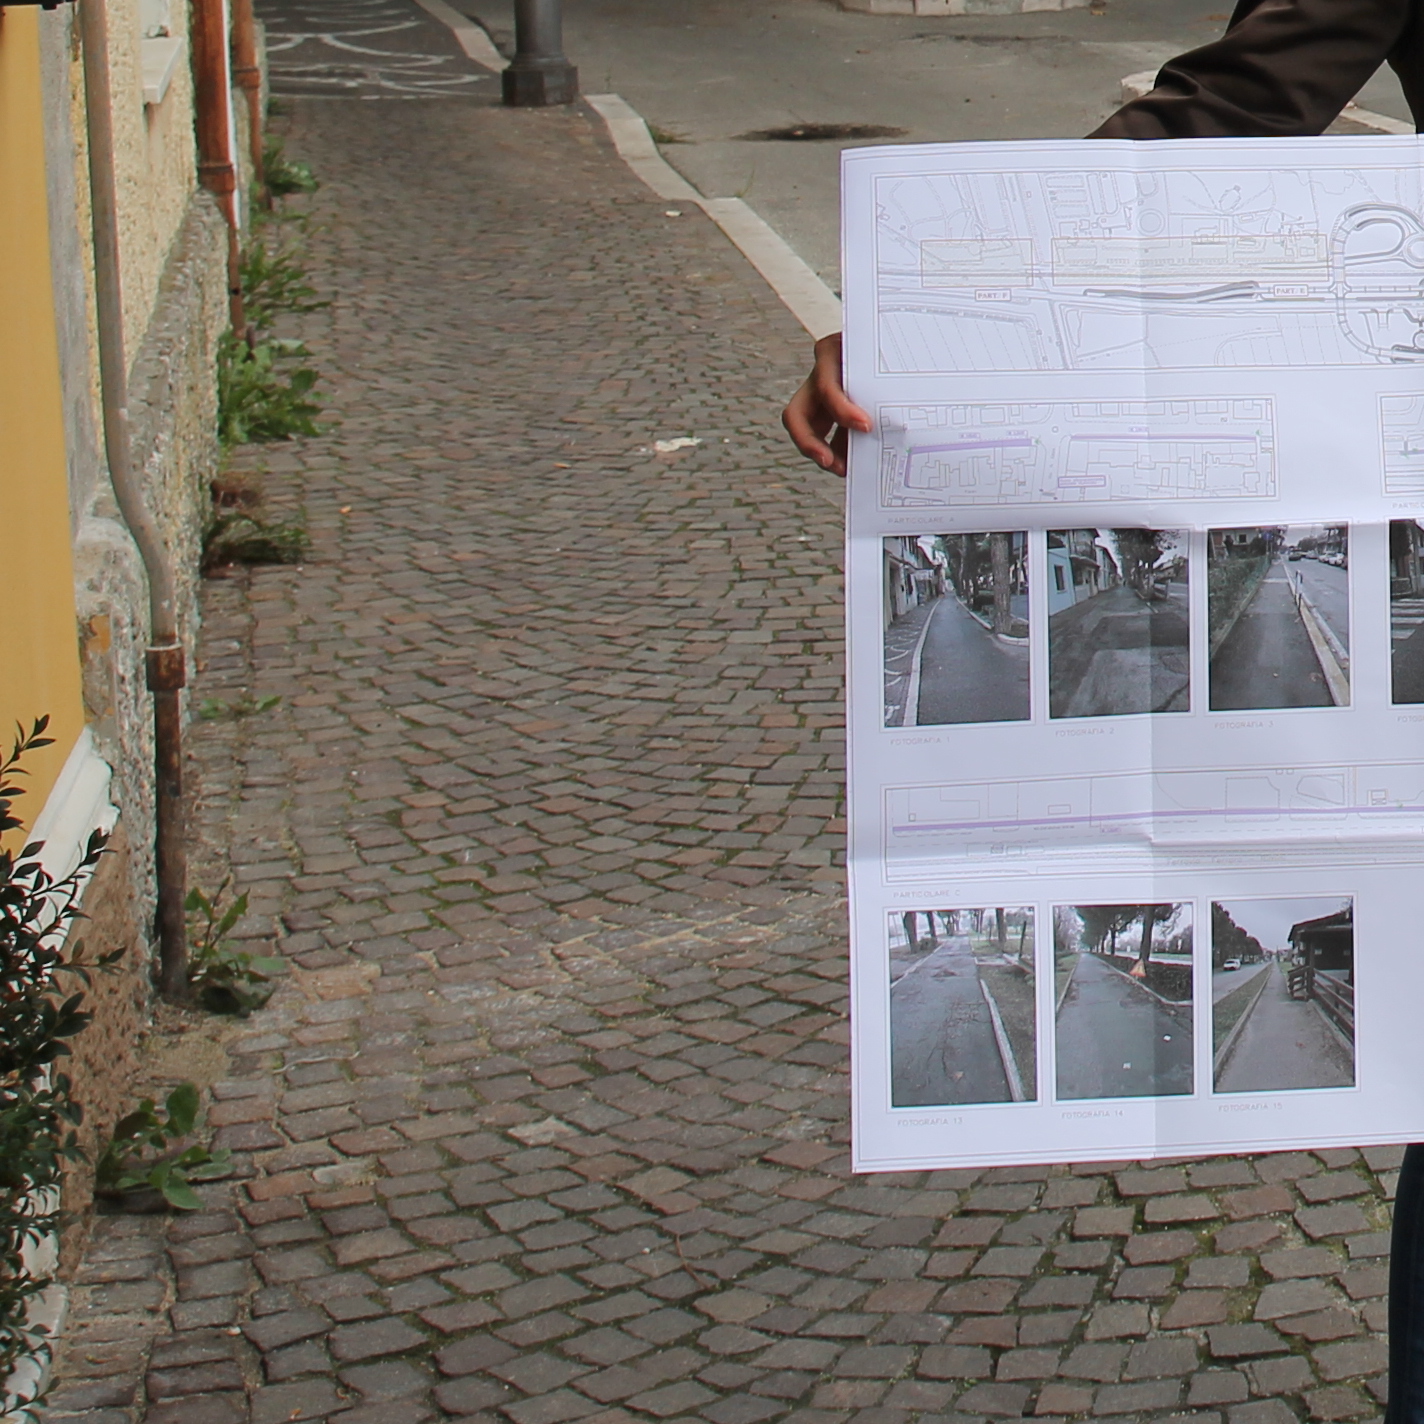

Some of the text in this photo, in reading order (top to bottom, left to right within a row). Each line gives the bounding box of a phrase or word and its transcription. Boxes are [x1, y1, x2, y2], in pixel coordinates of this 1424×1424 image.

[1214, 721, 1263, 729] FOTOGRAFIA
[1055, 727, 1105, 737] FOTOGRAFIA
[890, 737, 942, 745] FOTOGRAFIA
[893, 889, 950, 898] PARTICOLARE
[1218, 1102, 1283, 1112] FOTOGRAFIA 15
[1062, 1109, 1123, 1119] FOTOGRAFIA 14
[897, 1116, 963, 1127] FOTOGRAFIA 13
